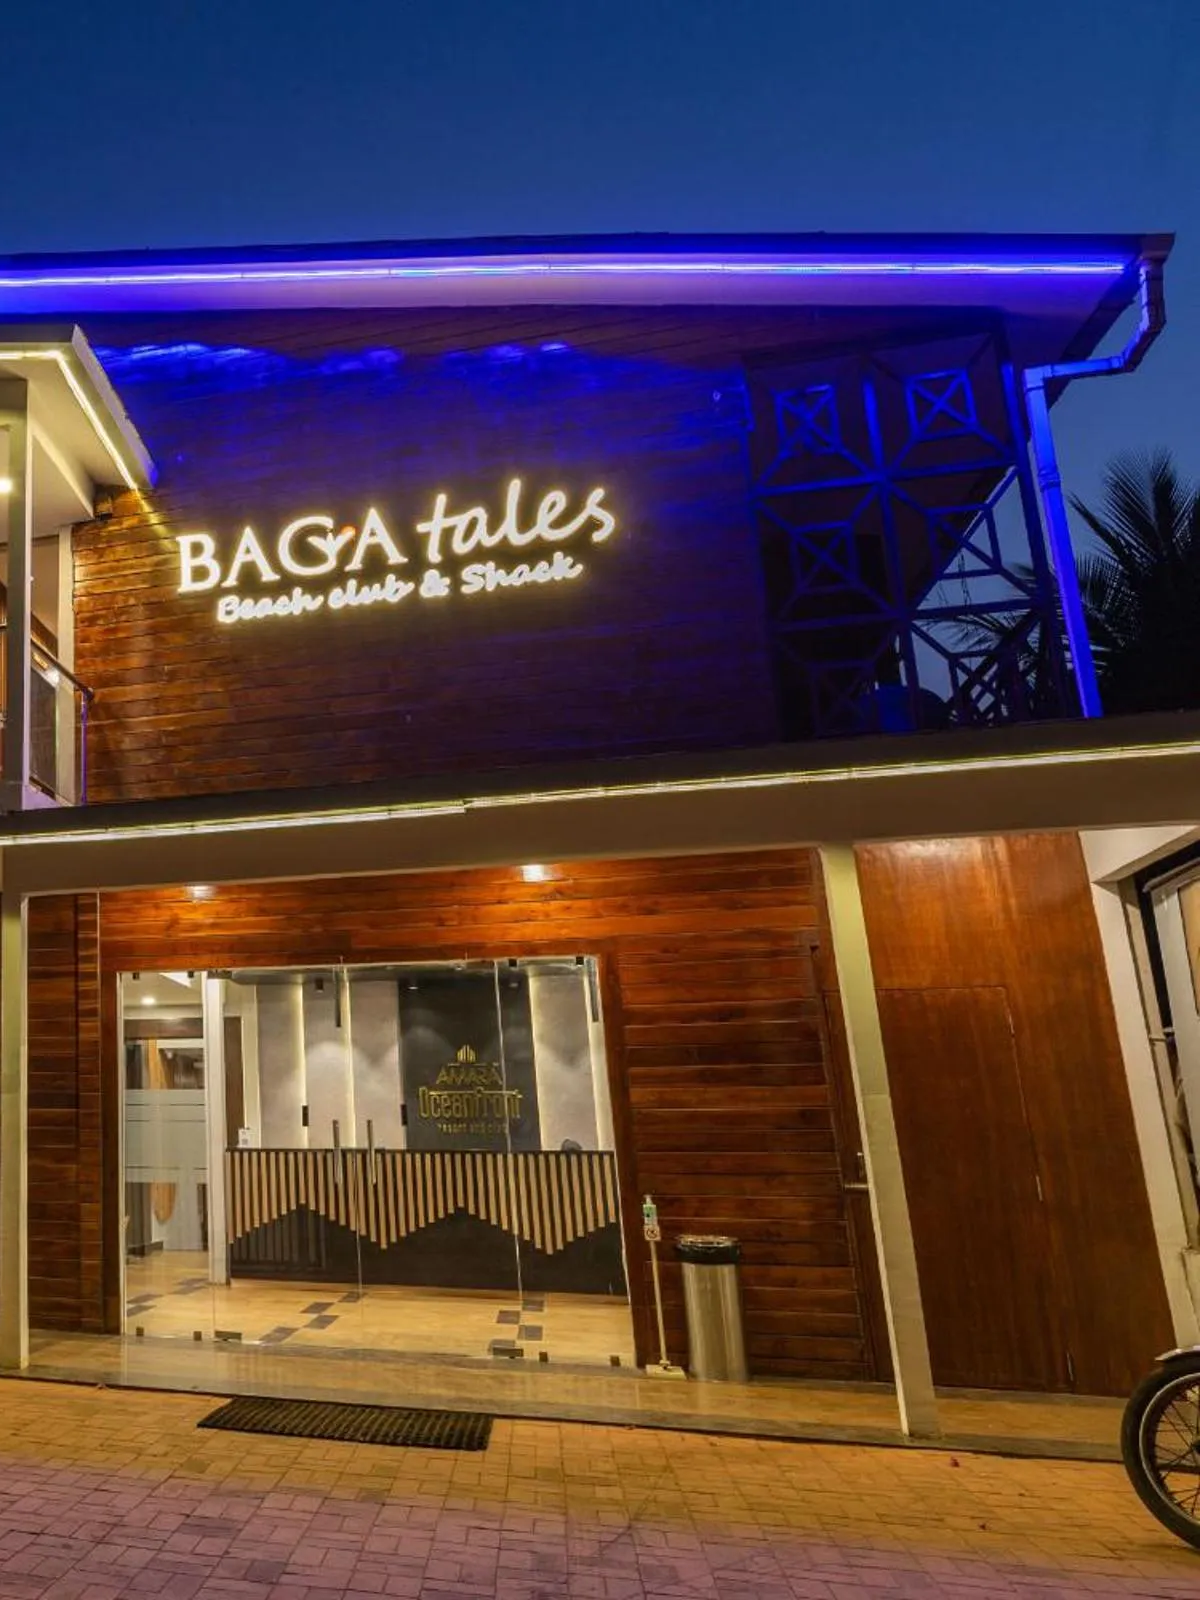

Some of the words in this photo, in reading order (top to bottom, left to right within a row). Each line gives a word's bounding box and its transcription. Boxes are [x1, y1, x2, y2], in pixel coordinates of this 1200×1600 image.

[176, 508, 408, 594] BAGA
[417, 478, 615, 564] tales
[216, 587, 325, 623] Beach
[328, 573, 414, 609] club
[419, 568, 451, 598] &
[460, 551, 584, 594] Shack
